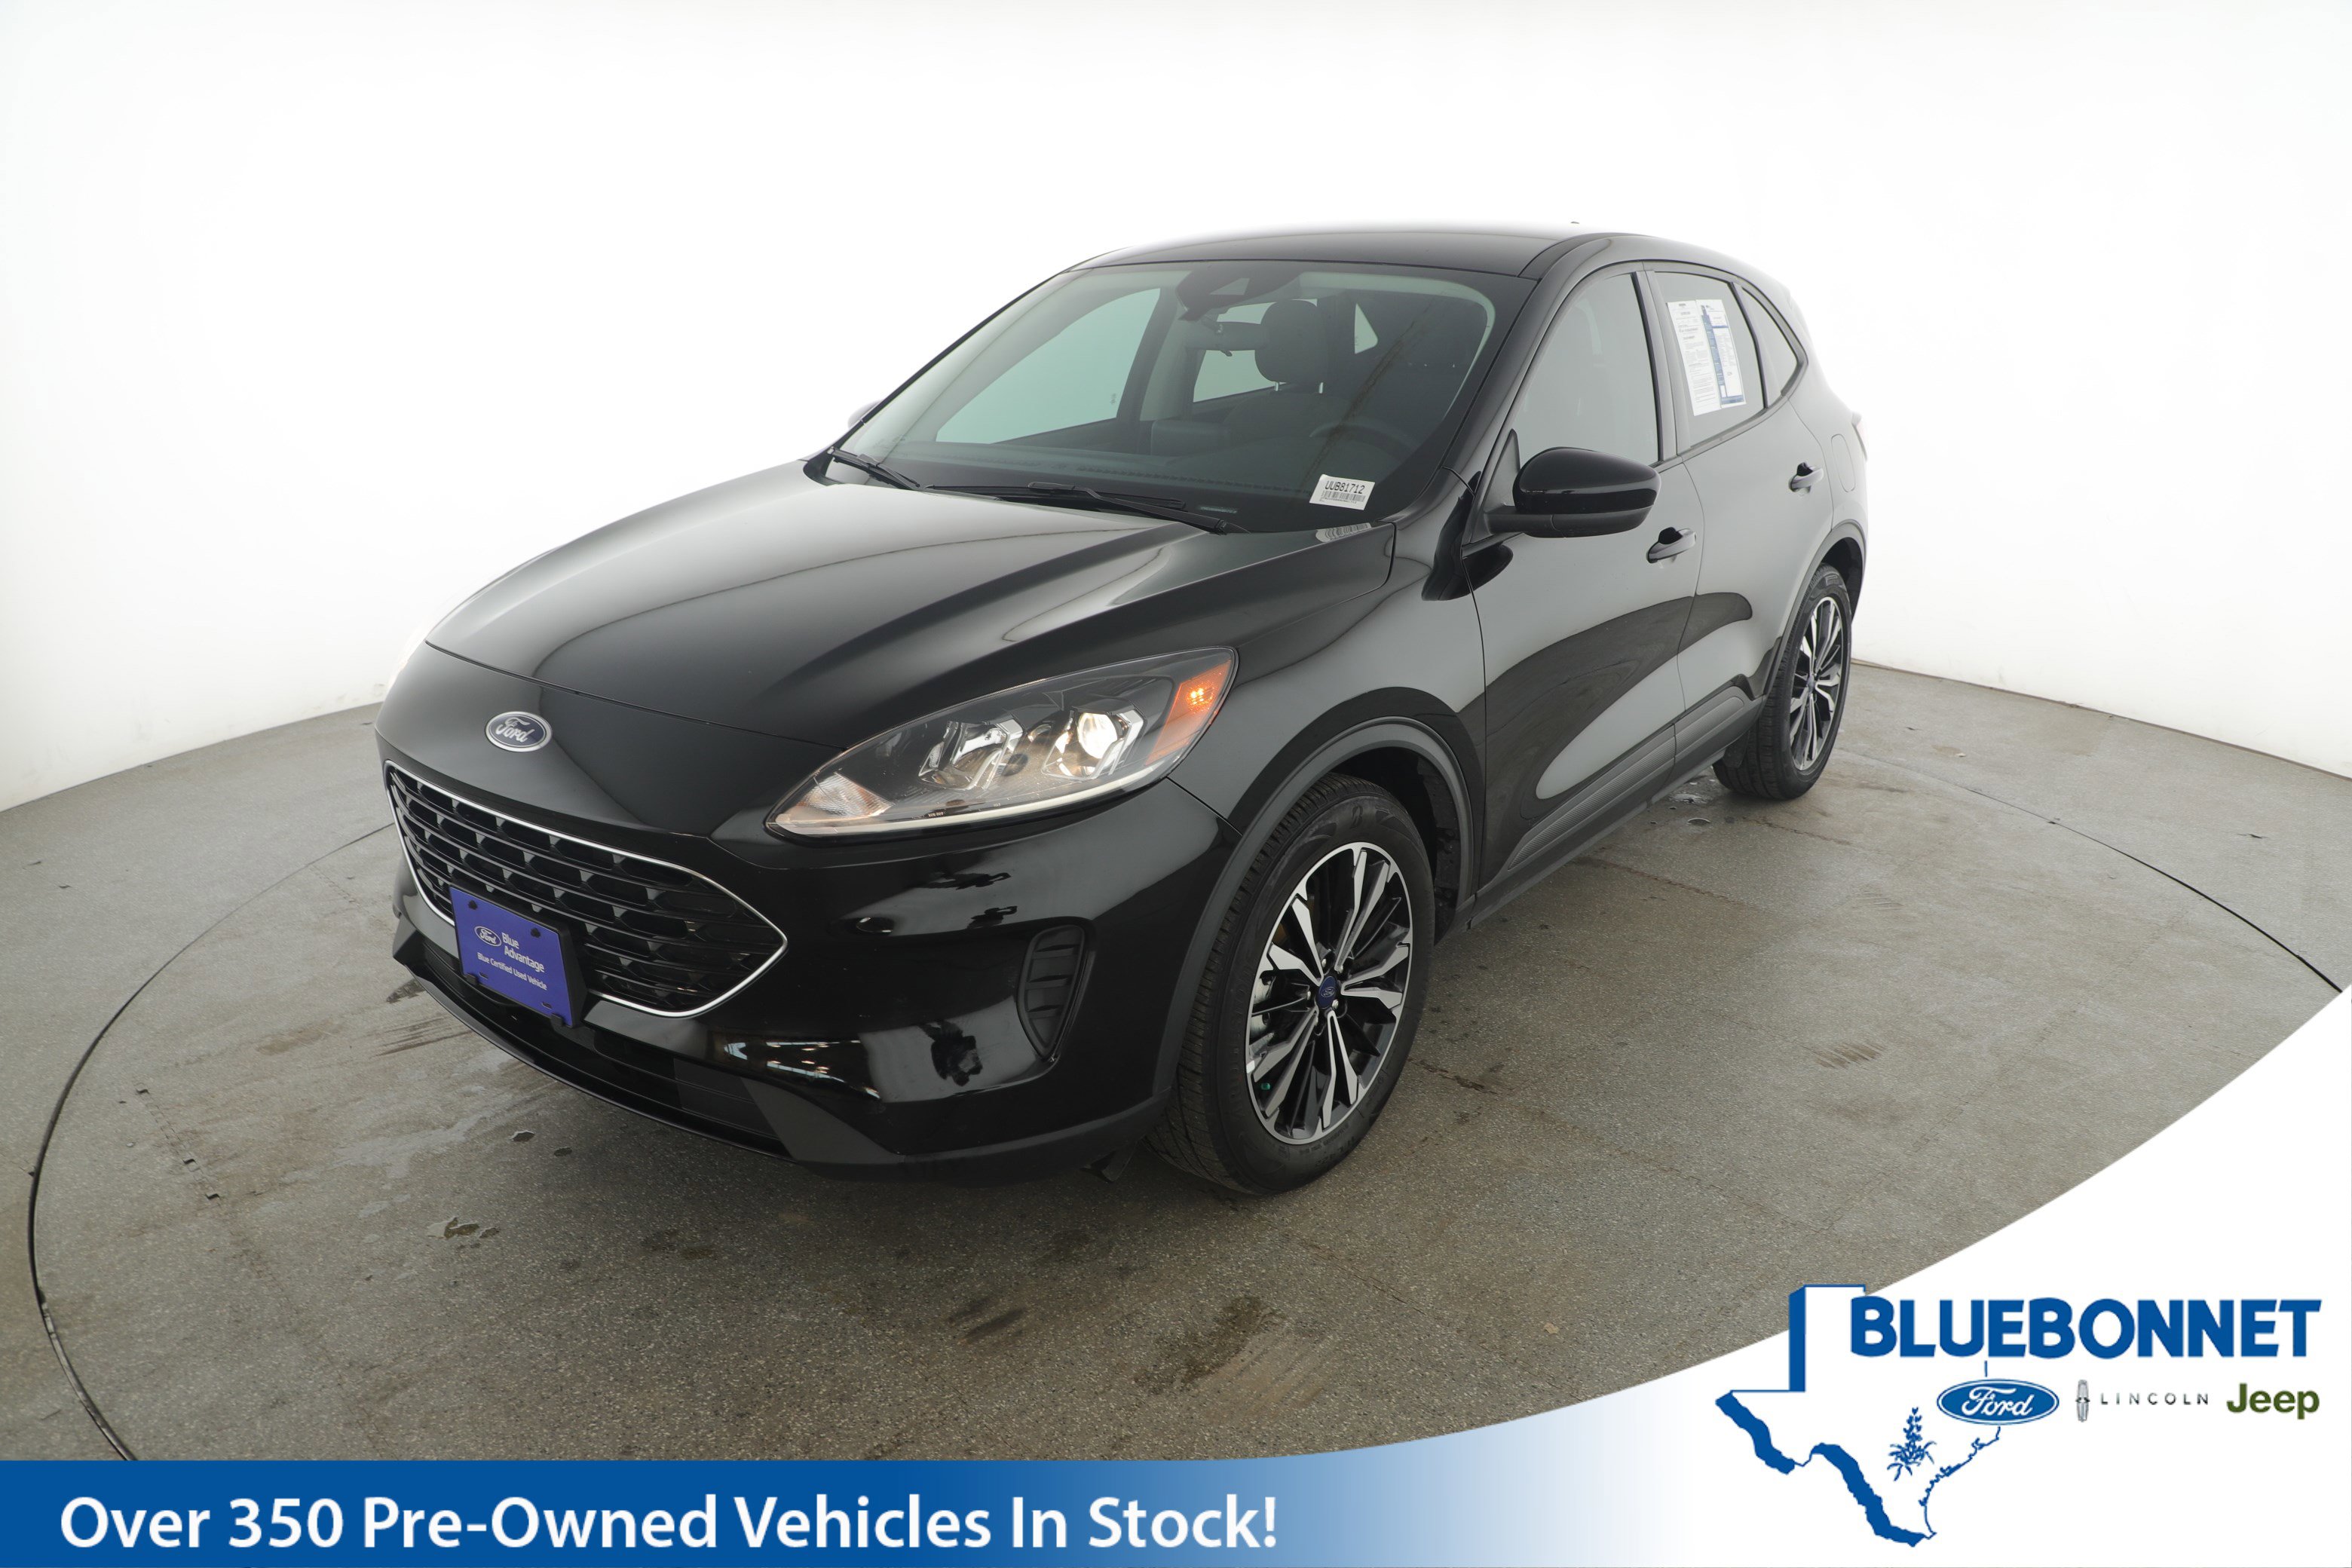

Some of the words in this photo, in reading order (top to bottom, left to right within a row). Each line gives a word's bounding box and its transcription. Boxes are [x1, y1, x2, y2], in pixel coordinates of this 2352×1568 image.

[1325, 480, 1365, 494] UUB81712
[495, 717, 535, 743] Ford
[479, 928, 497, 945] Ford
[501, 932, 519, 949] Blue
[504, 945, 545, 973] Advantage
[476, 951, 490, 964] Blue
[490, 957, 513, 974] Certified
[513, 967, 528, 982] Used
[527, 974, 547, 991] Vehicle
